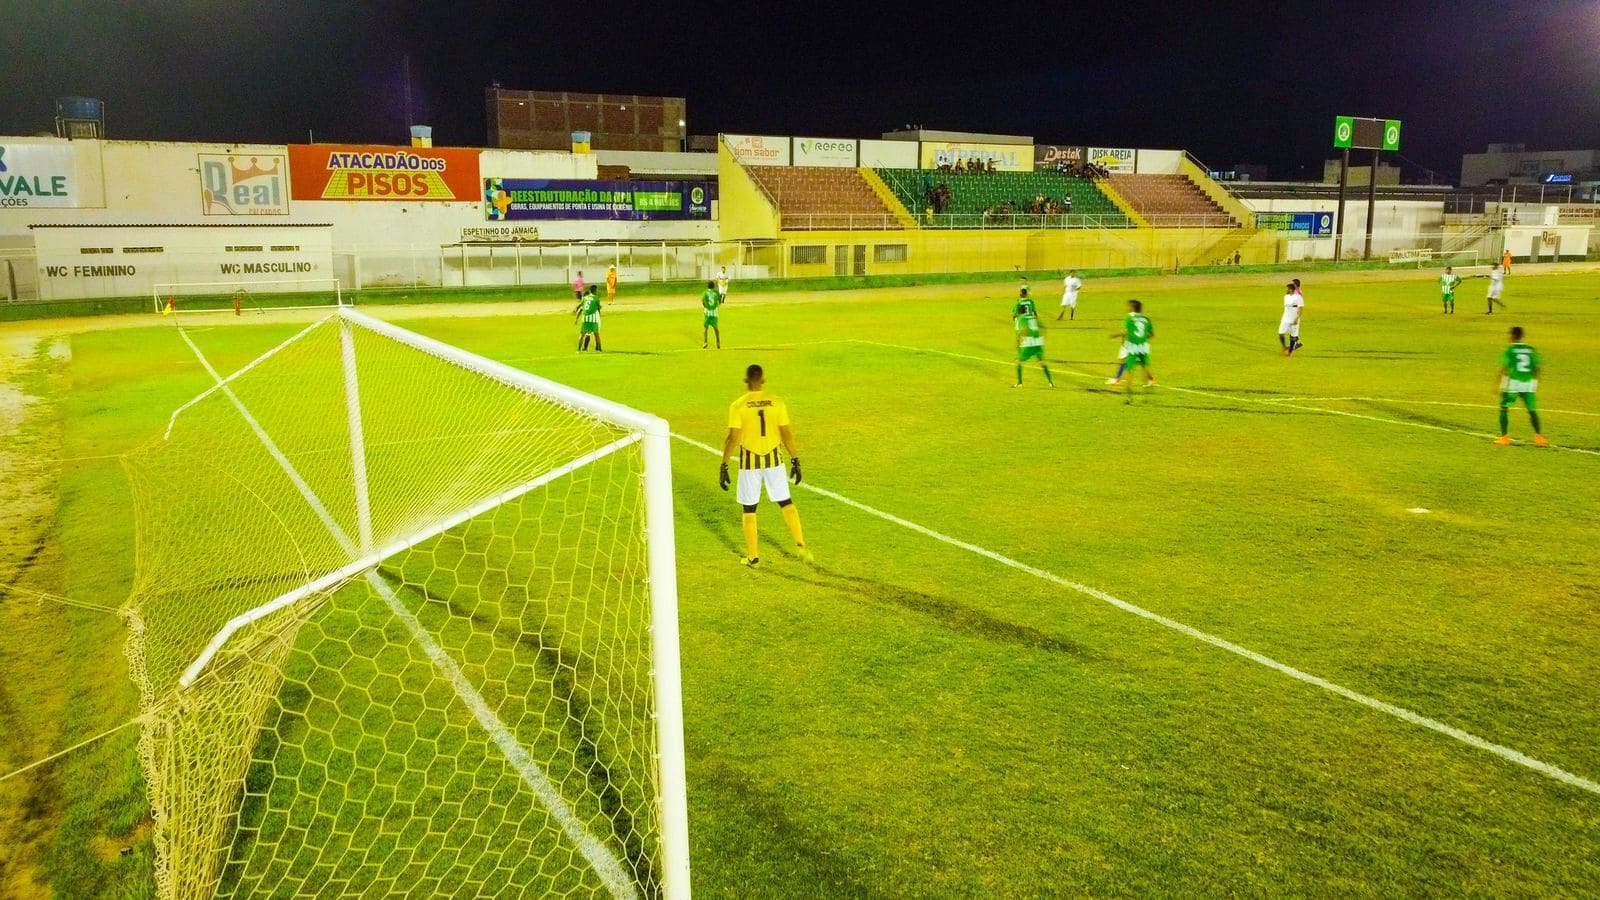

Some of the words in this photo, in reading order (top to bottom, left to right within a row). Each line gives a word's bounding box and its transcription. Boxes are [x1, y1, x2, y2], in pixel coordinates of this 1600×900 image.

[329, 152, 420, 170] ATACADÃO
[421, 159, 445, 170] DOS
[1044, 146, 1081, 162] Destak
[1092, 149, 1109, 160] DISK
[347, 172, 429, 196] PISOS
[0, 197, 28, 207] ÇÕES
[510, 188, 598, 203] REESTRUTURAÇÃO
[599, 191, 612, 203] DA
[463, 227, 500, 236] ESPETINHO
[500, 227, 510, 235] DO
[511, 226, 538, 235] JAMAICA
[46, 265, 68, 278] WC
[74, 264, 136, 277] FEMININO
[220, 263, 240, 275] WC
[243, 262, 311, 275] MASCULINO
[1133, 320, 1146, 338] 3
[1516, 353, 1531, 372] 2
[758, 409, 766, 437] 1
